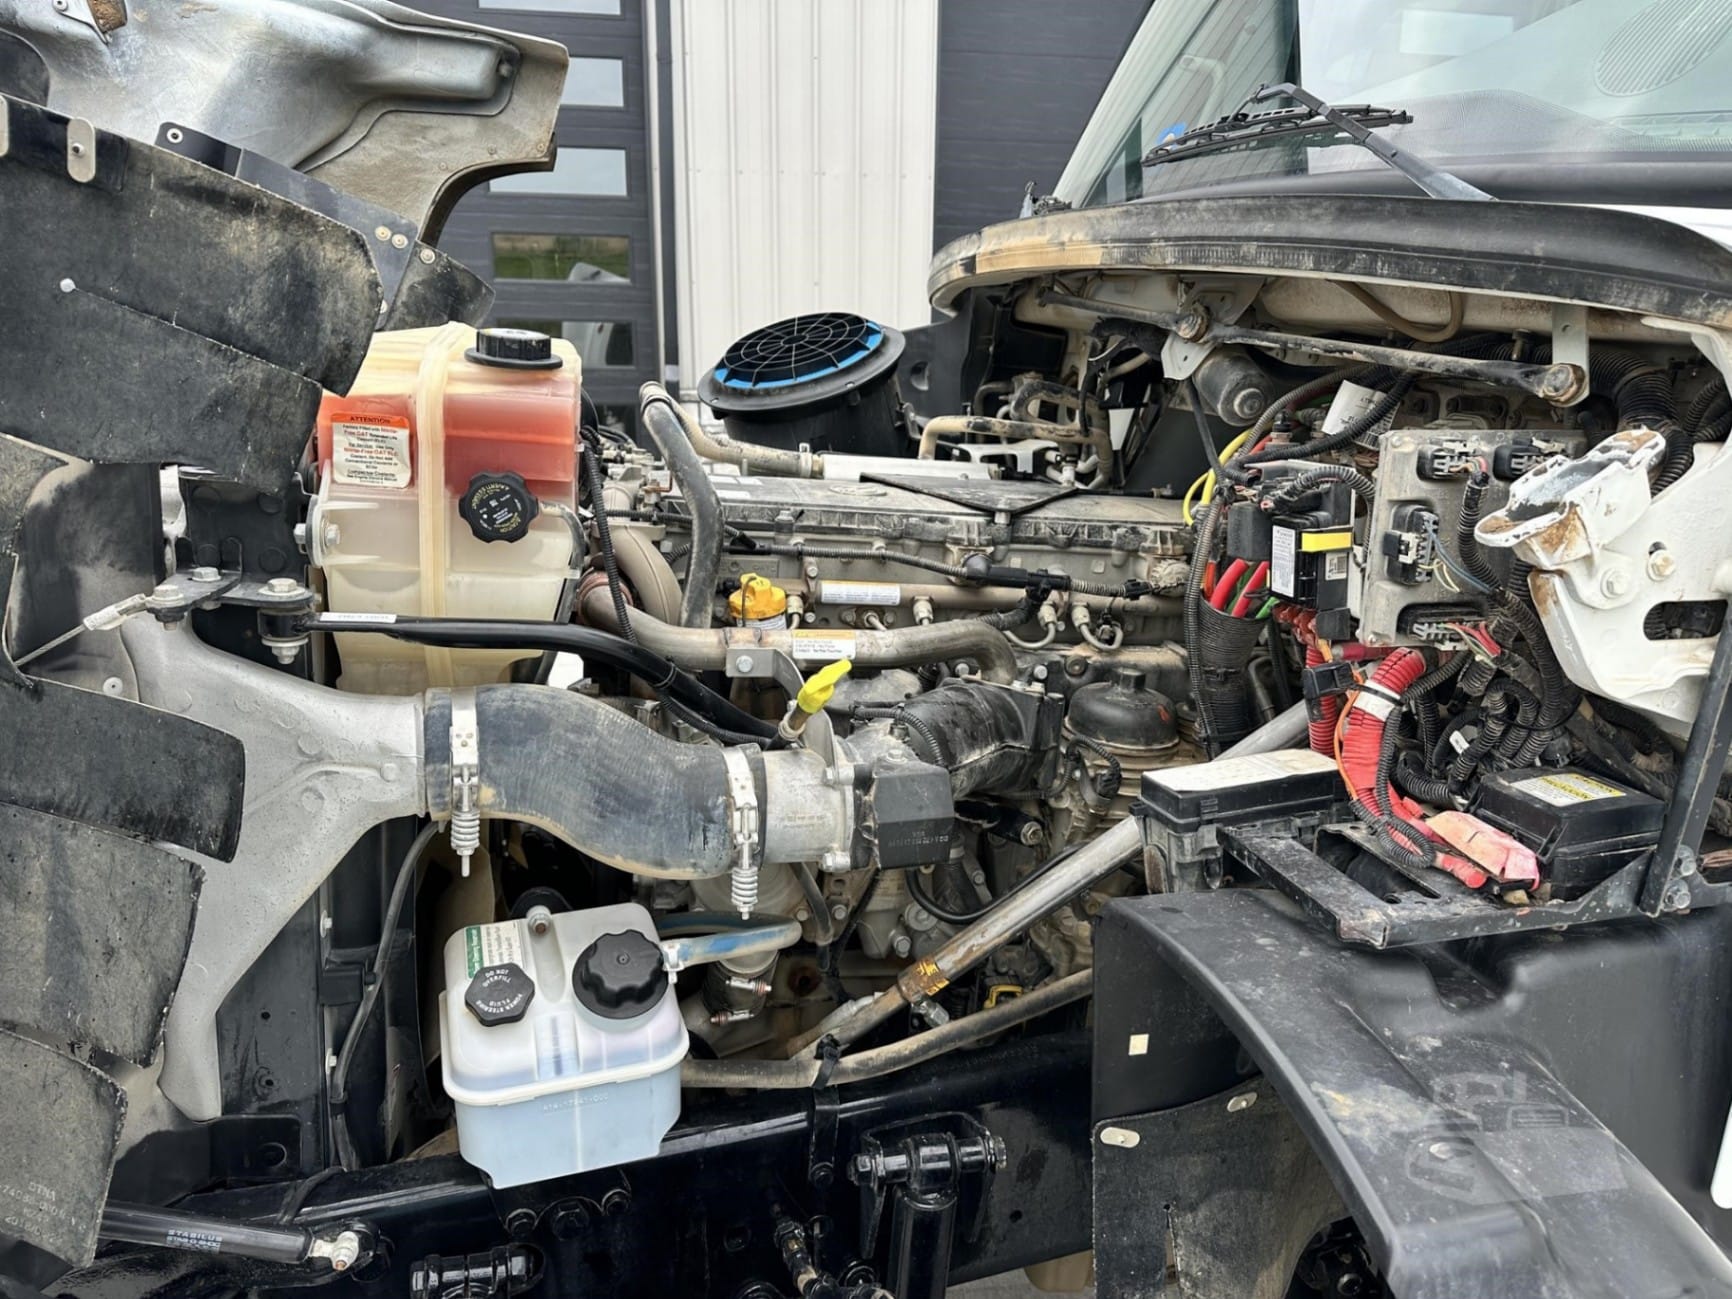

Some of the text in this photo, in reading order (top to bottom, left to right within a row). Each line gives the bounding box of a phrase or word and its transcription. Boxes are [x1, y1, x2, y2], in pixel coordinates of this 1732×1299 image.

[350, 415, 391, 424] ATTENTION
[485, 970, 495, 978] DO
[482, 975, 512, 987] OVERFILL
[168, 1229, 222, 1242] STABILUS
